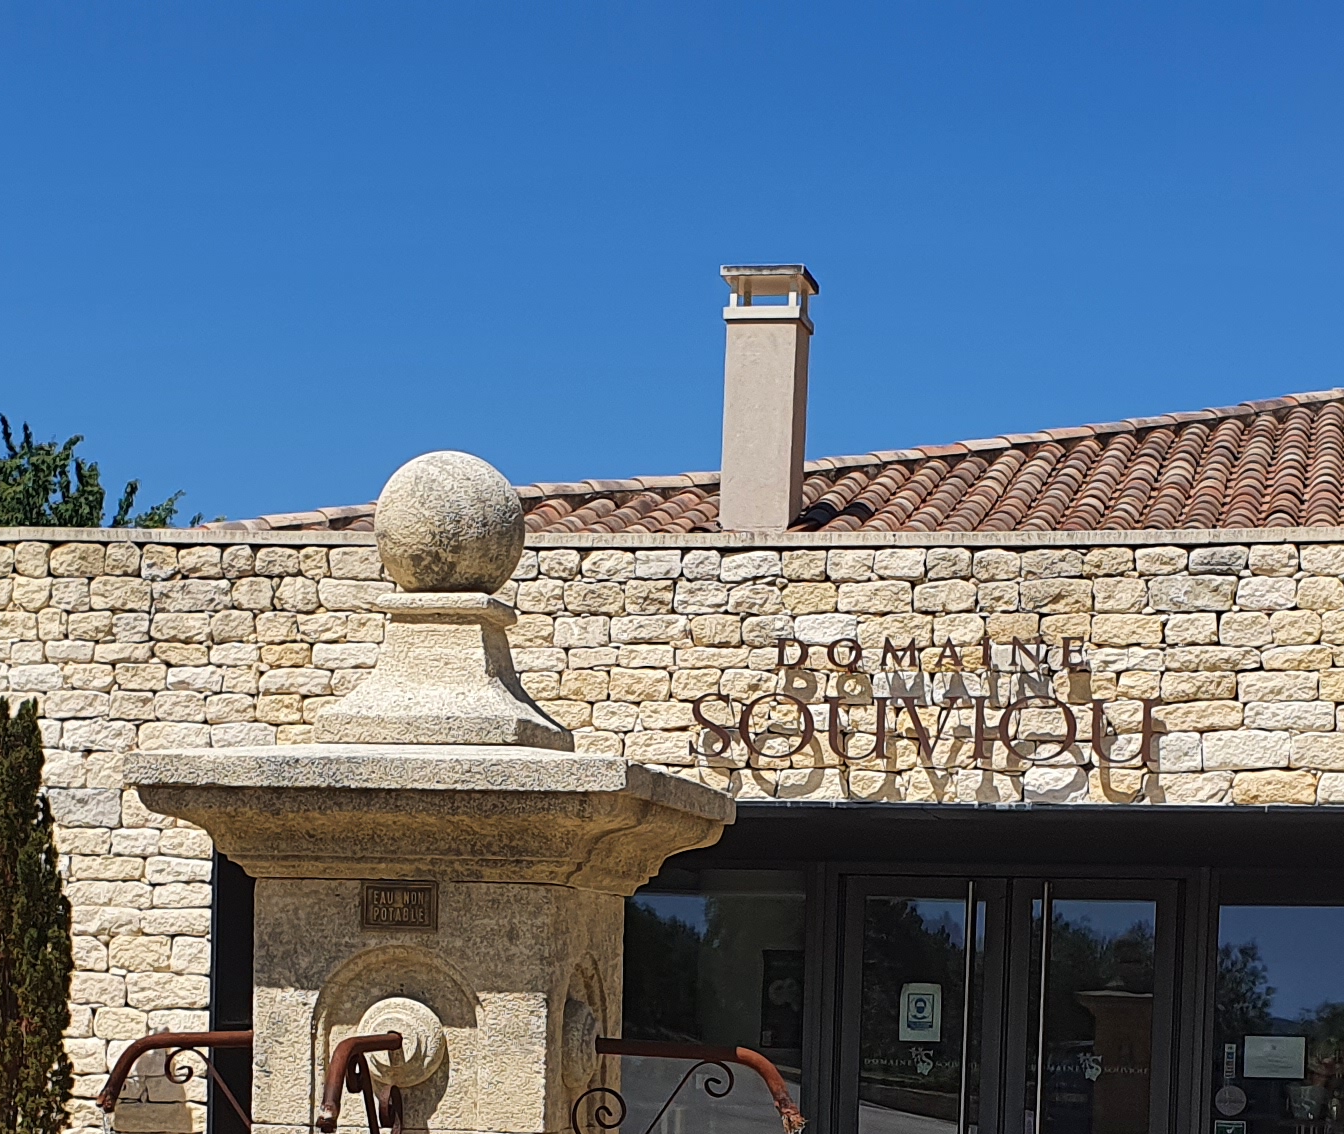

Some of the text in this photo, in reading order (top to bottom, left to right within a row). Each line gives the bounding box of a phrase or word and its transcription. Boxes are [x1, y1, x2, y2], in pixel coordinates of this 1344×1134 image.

[775, 636, 1089, 669] DOMAINE
[688, 692, 1158, 763] SOUVIOU
[373, 890, 425, 905] EAU NON
[373, 907, 425, 922] POTABLE
[863, 1057, 912, 1067] DOMAINE
